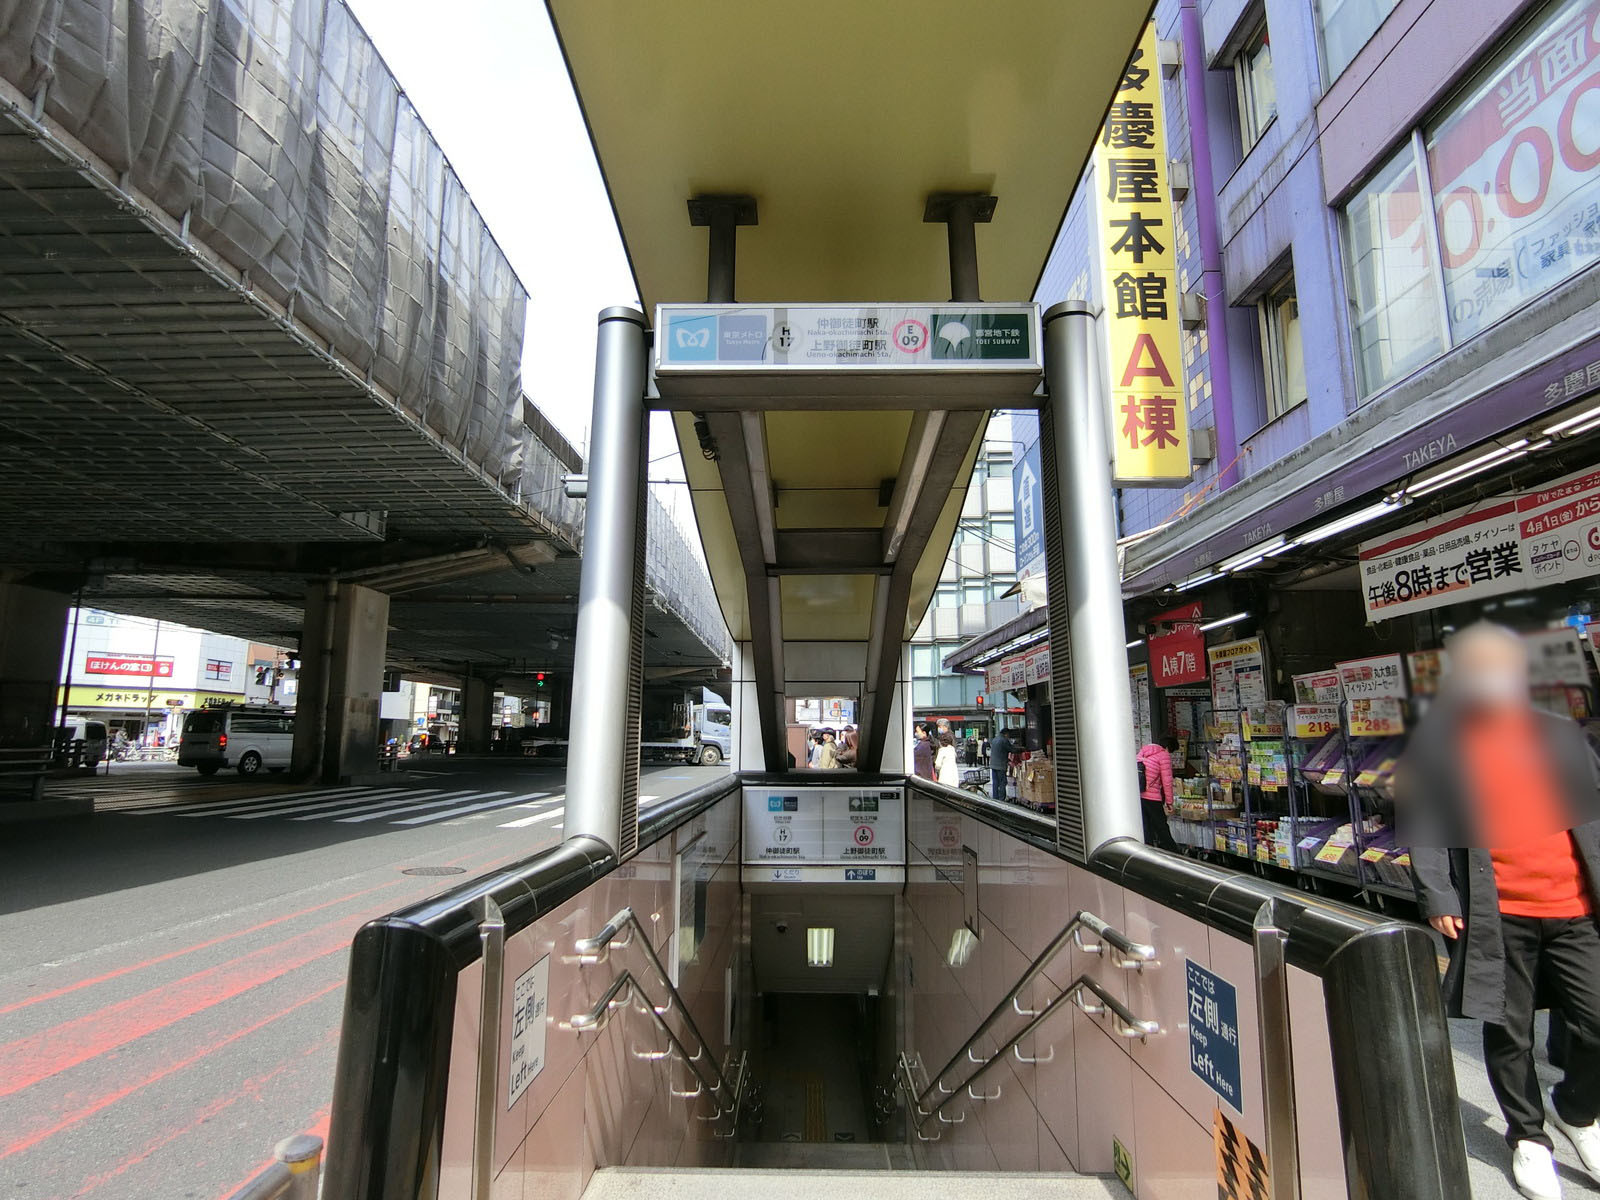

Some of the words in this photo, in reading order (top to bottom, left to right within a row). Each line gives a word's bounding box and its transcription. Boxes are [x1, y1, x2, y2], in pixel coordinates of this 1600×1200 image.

[817, 317, 880, 329] 仲御徒町駅
[907, 325, 914, 335] E
[723, 330, 762, 339] 東京メトロ
[975, 328, 1020, 337] 都営地下鉄
[810, 339, 887, 351] 上野御徒町駅
[902, 335, 919, 346] 09
[1402, 432, 1457, 471] TAKEYA
[1314, 485, 1344, 513] 多慶屋
[1242, 522, 1273, 547] TAKEYA
[1532, 540, 1559, 555] タケヤ
[1368, 540, 1523, 608] 午後8時まで営業
[1534, 560, 1561, 574] ポイント
[90, 660, 153, 673] ほけんの窓口
[1162, 650, 1196, 678] A棟7階
[1373, 664, 1398, 678] 丸大食品
[95, 693, 159, 703] メガネドラッグ
[1308, 721, 1331, 733] 218
[1364, 719, 1390, 732] 285
[779, 834, 788, 842] 17
[859, 834, 869, 842] 09
[843, 847, 886, 855] 上野御徒町駅
[1187, 965, 1215, 995] ここでは
[513, 991, 536, 1041] 左側
[1189, 987, 1219, 1036] 左側
[1221, 1022, 1238, 1048] 通行
[1190, 1023, 1208, 1049] Keep
[511, 1043, 526, 1065] Keep
[510, 1061, 528, 1097] Left
[1191, 1050, 1215, 1081] Left
[1215, 1072, 1234, 1097] Here
